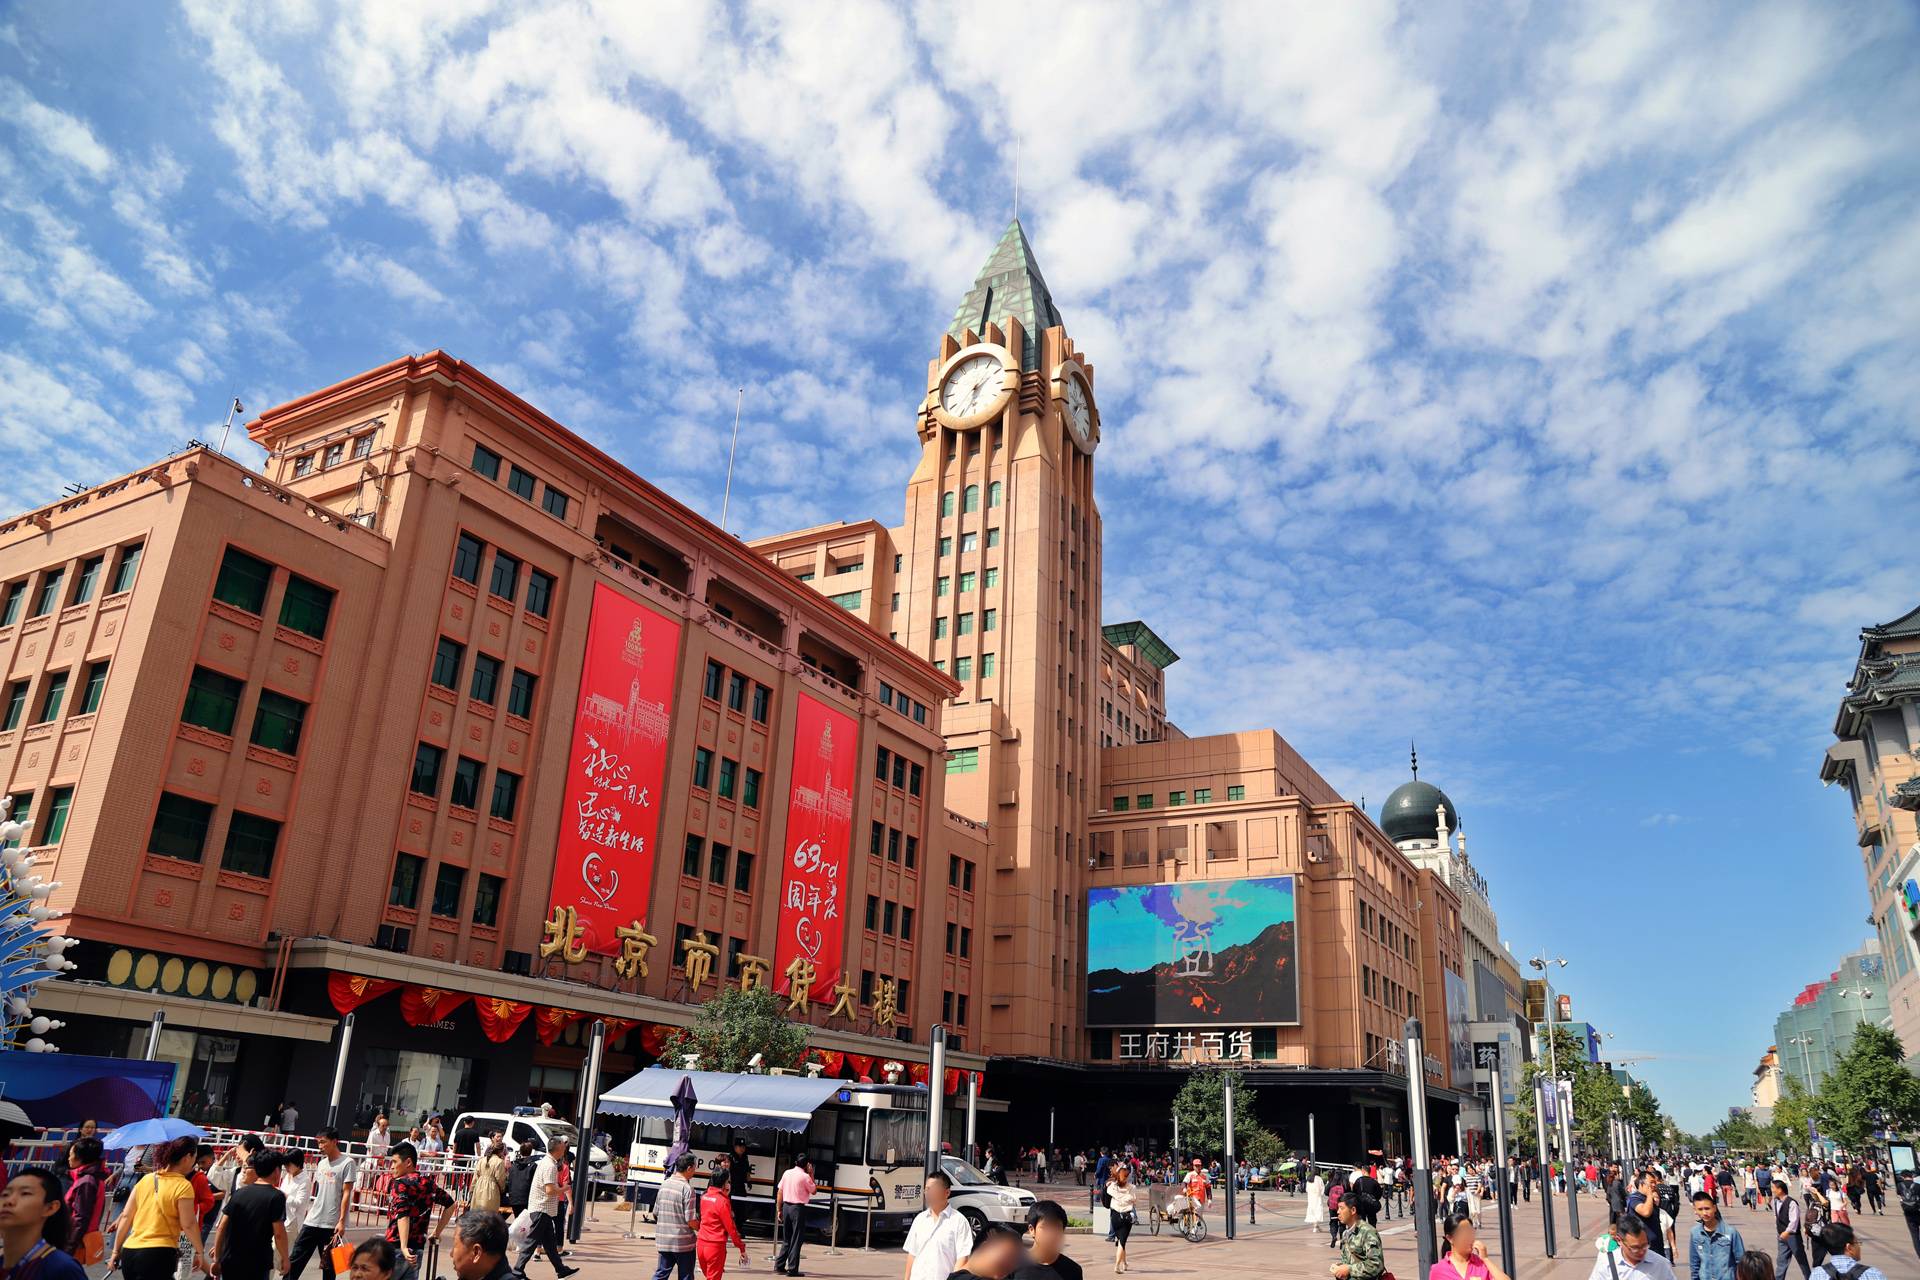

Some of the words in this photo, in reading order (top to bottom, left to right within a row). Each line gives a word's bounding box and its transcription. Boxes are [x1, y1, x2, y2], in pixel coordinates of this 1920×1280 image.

[539, 904, 899, 1028] 北京市百货大楼
[1119, 1031, 1253, 1059] 王府井百货
